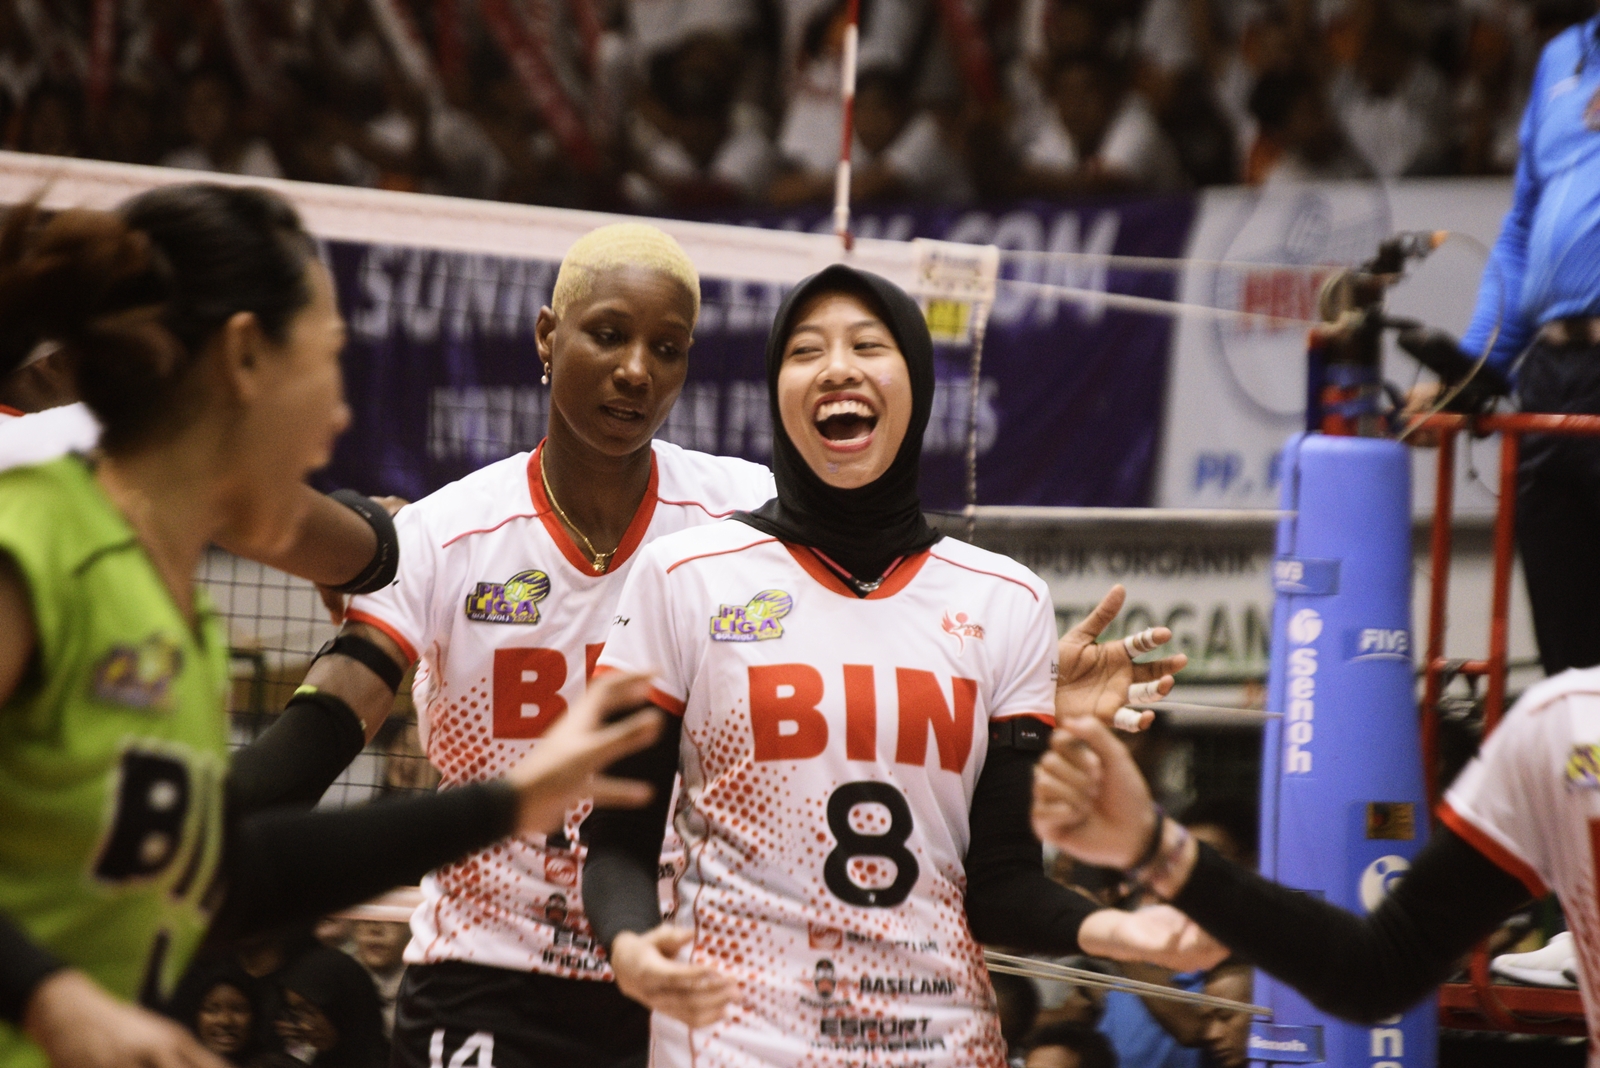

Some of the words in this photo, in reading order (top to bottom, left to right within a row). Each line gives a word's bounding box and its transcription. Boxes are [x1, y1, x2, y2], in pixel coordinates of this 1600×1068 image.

[470, 599, 535, 615] LIGA
[714, 617, 778, 634] LIGA
[748, 663, 978, 774] BIN
[823, 780, 920, 907] 8
